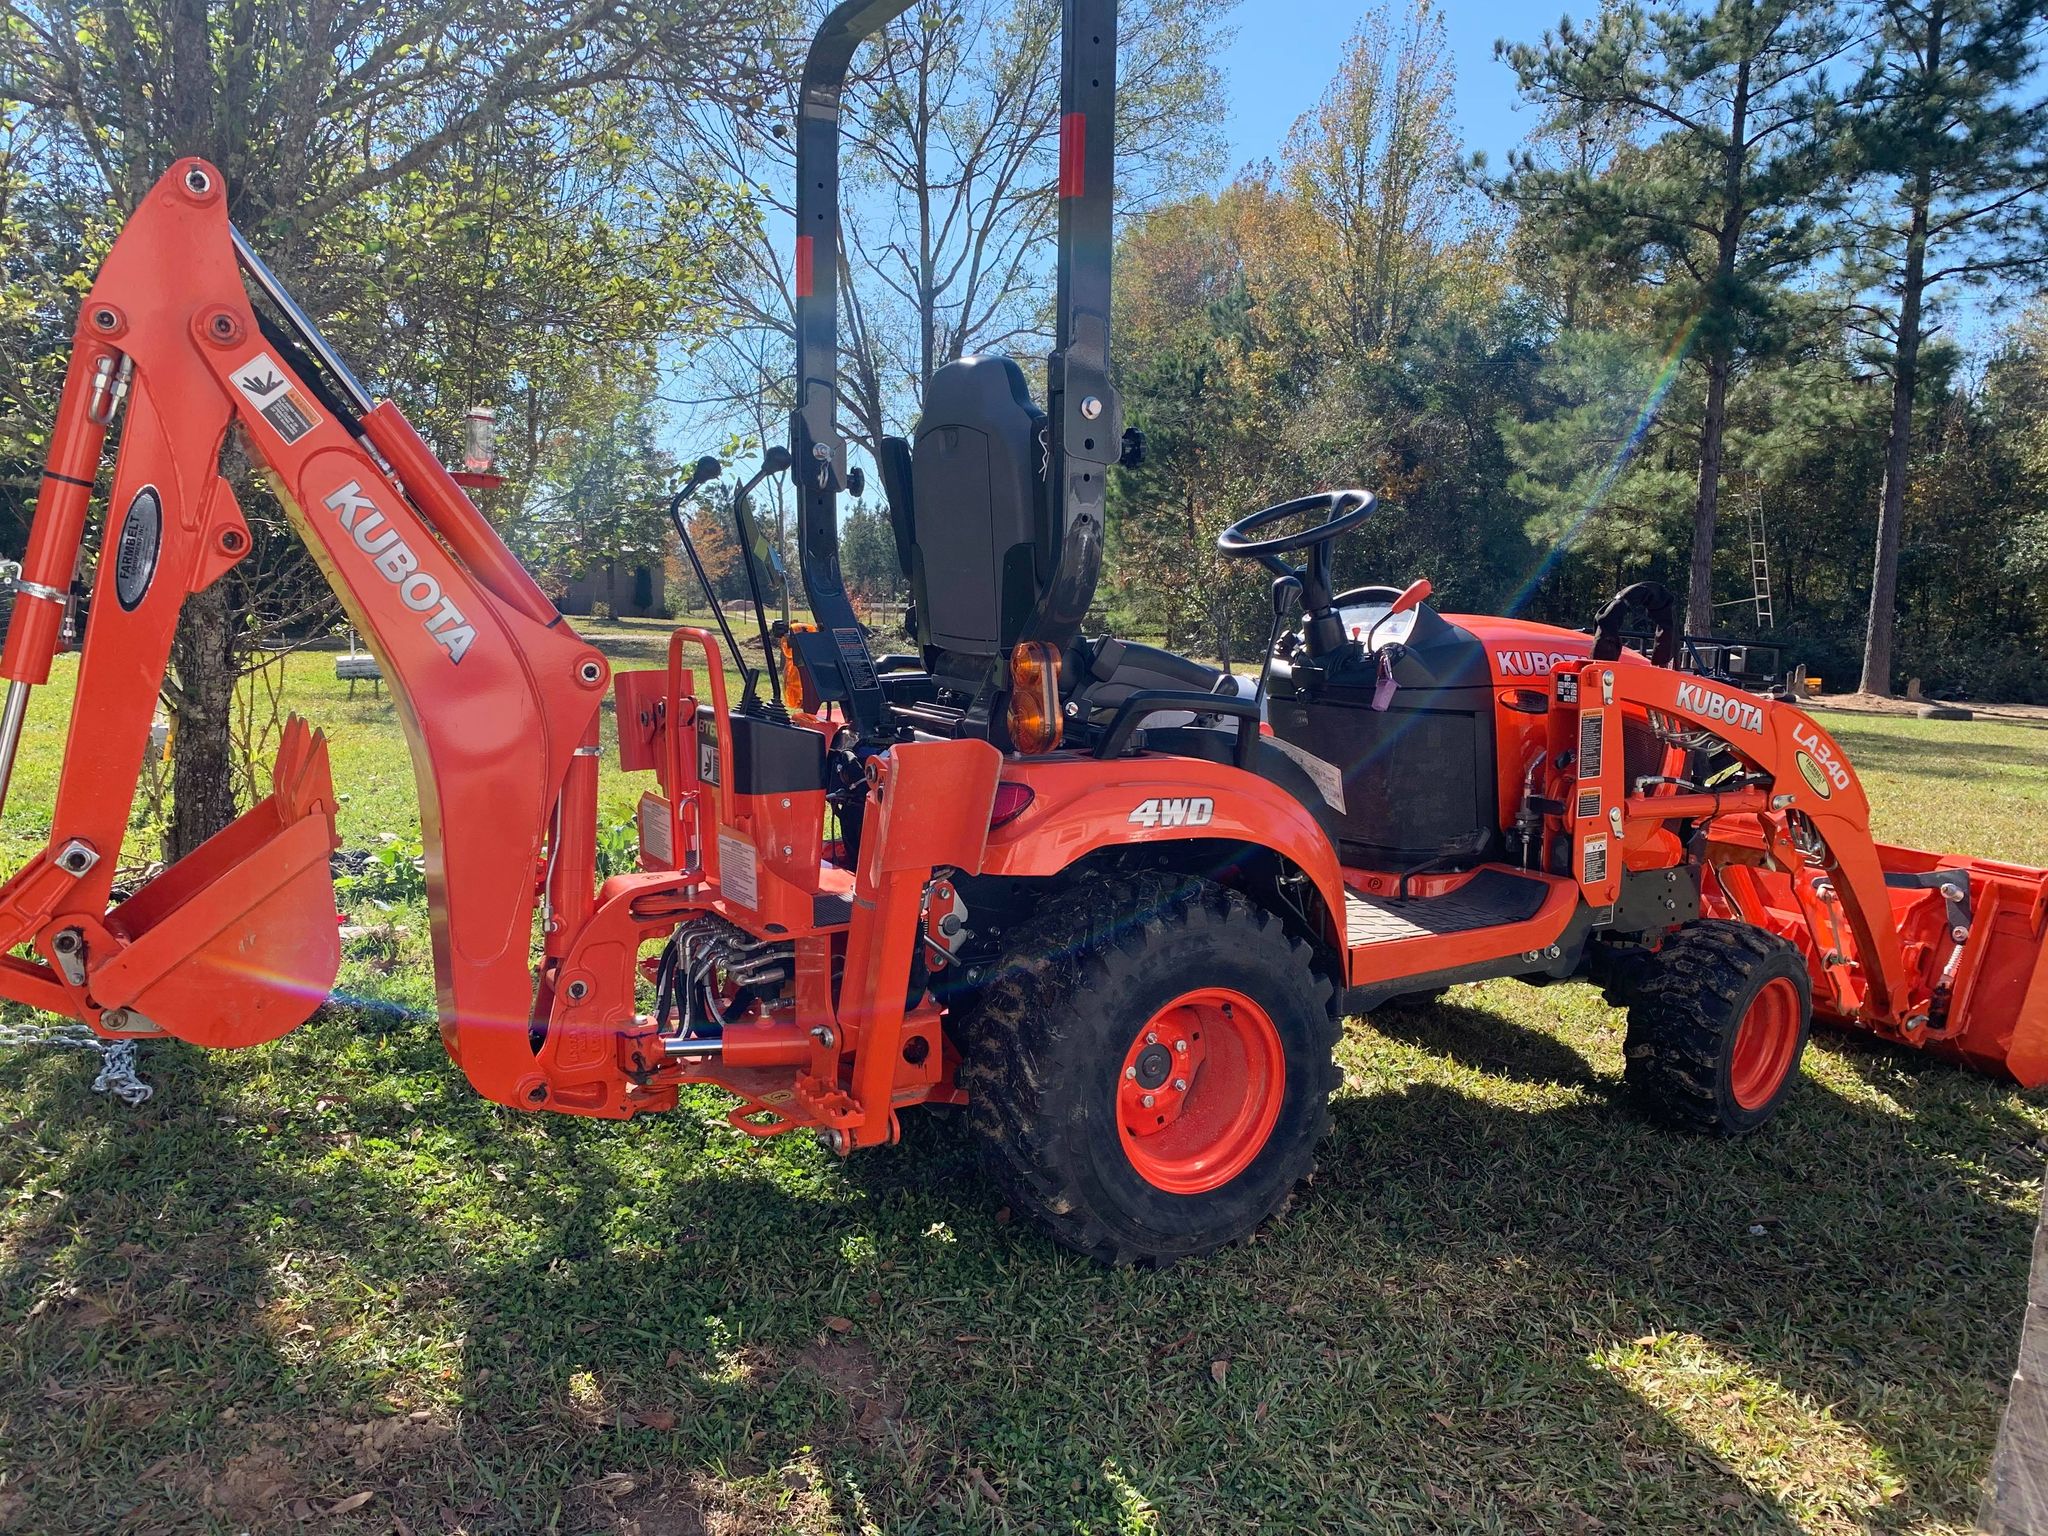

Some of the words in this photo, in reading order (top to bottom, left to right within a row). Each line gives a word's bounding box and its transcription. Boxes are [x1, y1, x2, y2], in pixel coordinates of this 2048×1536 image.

[120, 515, 140, 579] FARMBELT
[323, 480, 477, 665] KUBOTA
[1497, 651, 1590, 676] KUB
[1676, 681, 1763, 735] KUBOTA
[1793, 722, 1850, 791] LA340
[1128, 797, 1214, 828] 4WD
